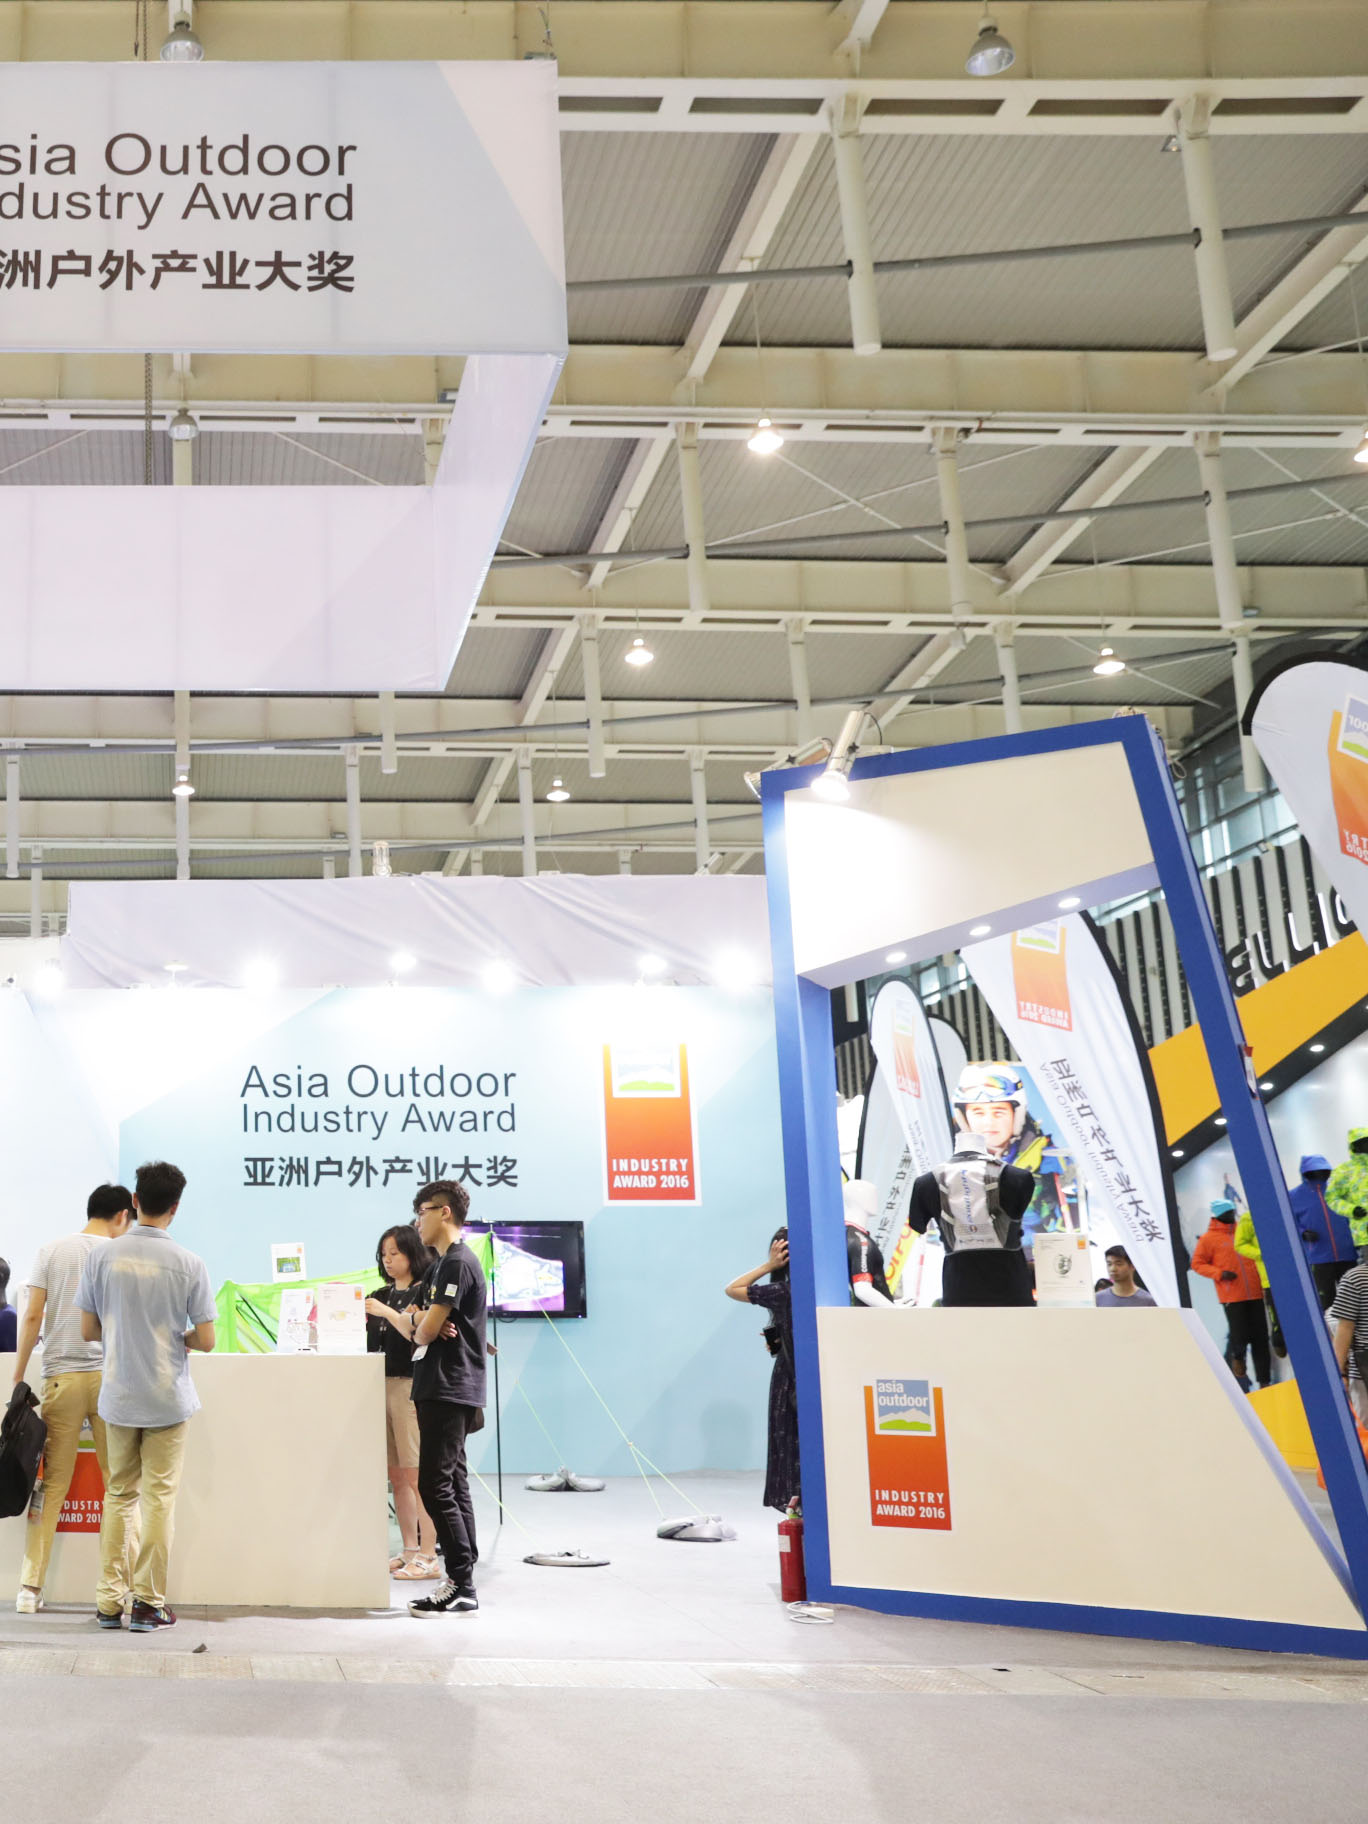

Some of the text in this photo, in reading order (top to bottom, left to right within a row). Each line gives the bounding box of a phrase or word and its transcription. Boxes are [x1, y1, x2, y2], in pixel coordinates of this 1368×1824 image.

[105, 133, 357, 176] Outdoor
[181, 182, 353, 221] Award
[240, 1064, 516, 1098] Asia Outdoor
[243, 1103, 516, 1140] Industry Award
[244, 1155, 518, 1188] 亚洲户外产业大奖
[612, 1158, 688, 1171] INDUSTRY
[613, 1175, 689, 1188] AWARD 2016
[878, 1381, 904, 1393] asia
[879, 1394, 928, 1407] outdoor
[875, 1489, 944, 1504] INDUSTRY
[64, 1500, 104, 1510] DUSTR
[876, 1504, 945, 1519] AWARD 2016
[58, 1513, 102, 1523] WARD 201
